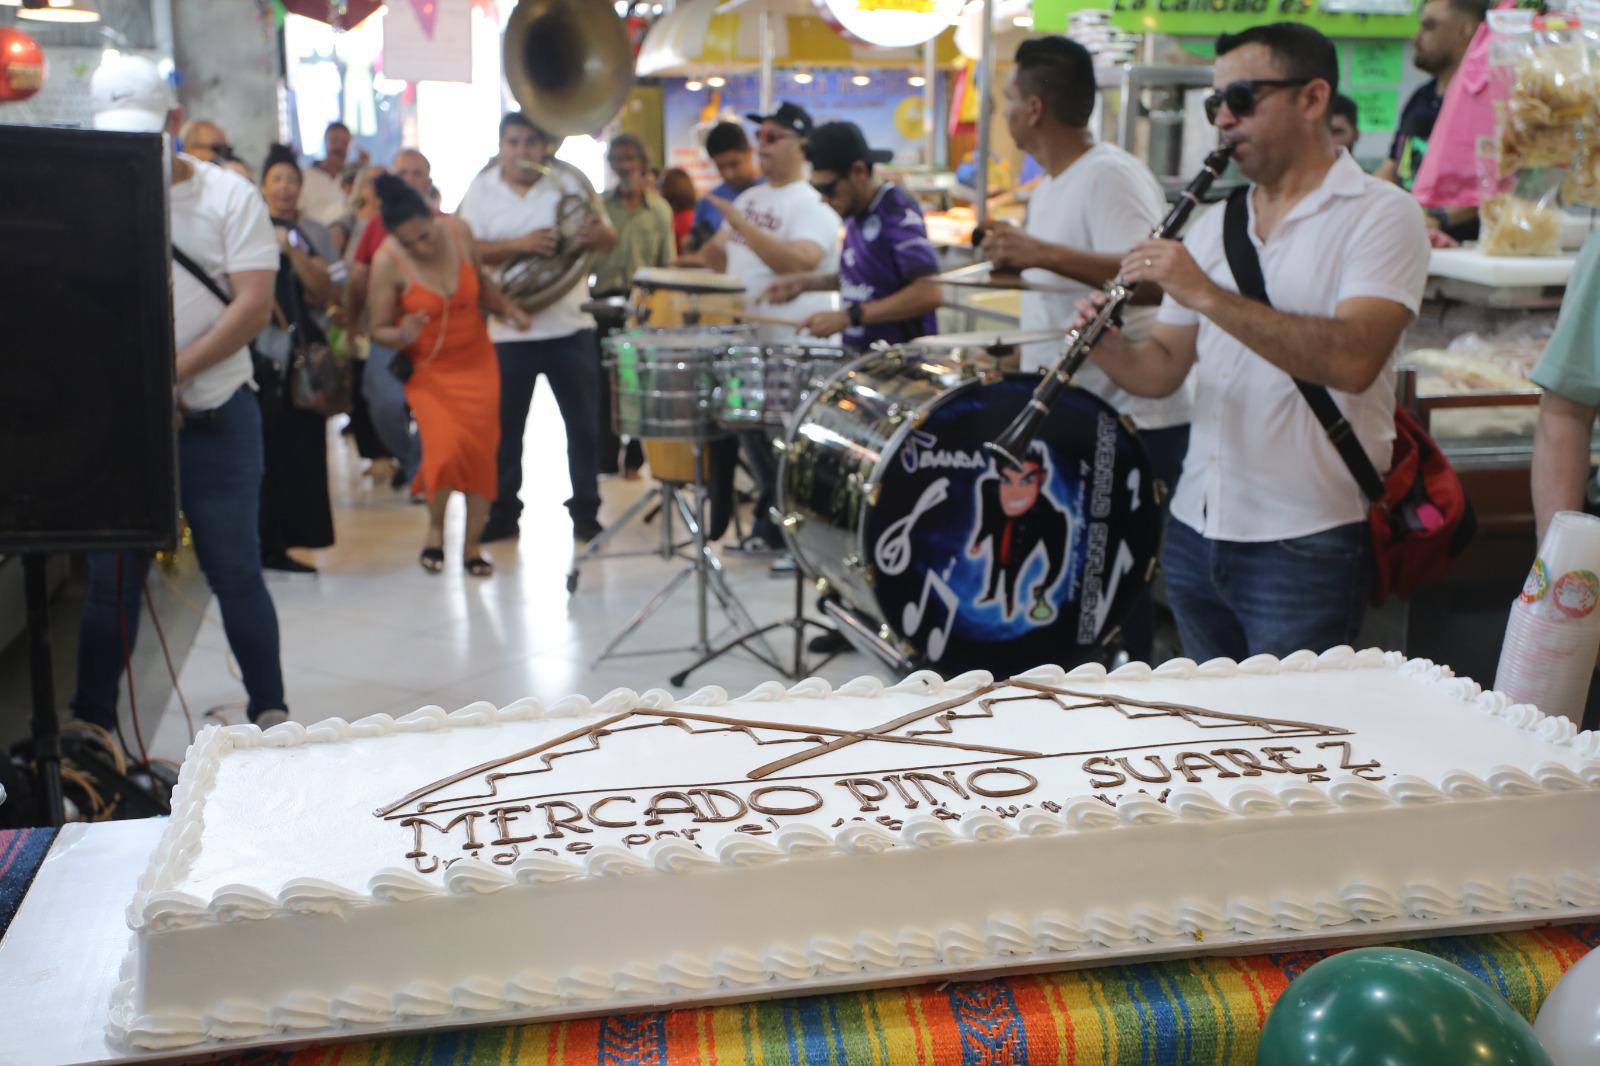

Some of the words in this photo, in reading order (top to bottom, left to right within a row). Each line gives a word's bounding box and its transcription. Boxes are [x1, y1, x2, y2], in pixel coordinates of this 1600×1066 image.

[400, 785, 824, 859] MERCADO
[834, 766, 1039, 812] PINO
[1082, 741, 1381, 789] SUAREZ
